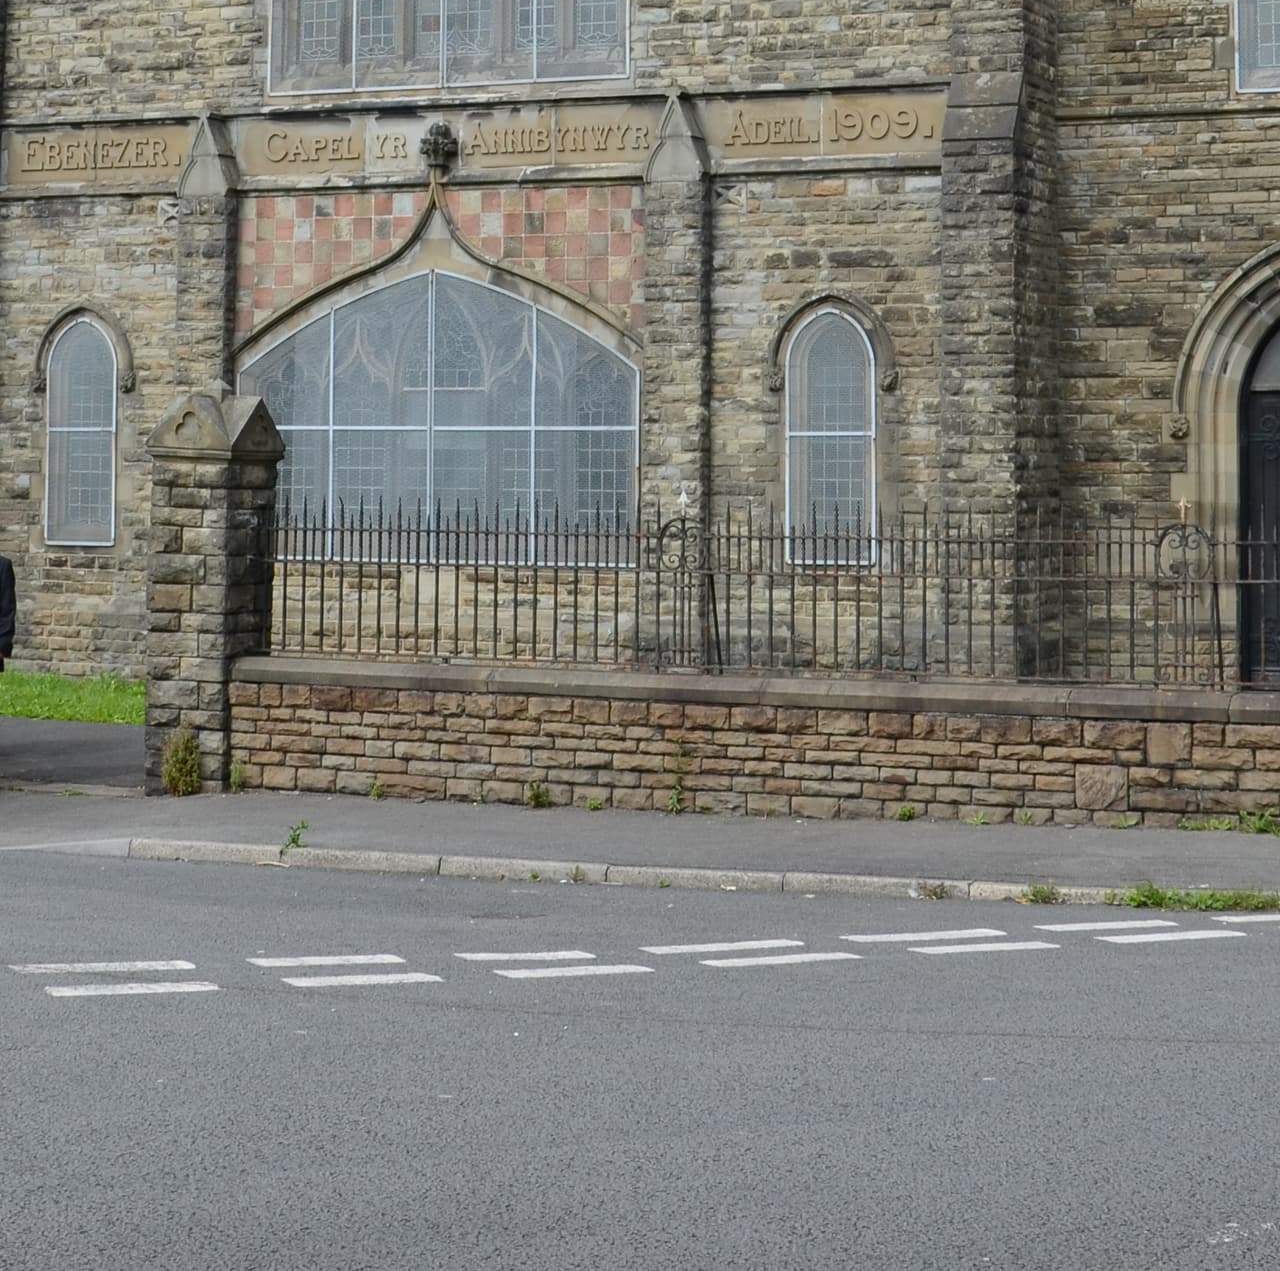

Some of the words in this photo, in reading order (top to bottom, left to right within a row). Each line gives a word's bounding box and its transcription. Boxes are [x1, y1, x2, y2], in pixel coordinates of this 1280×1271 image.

[263, 128, 360, 164] CAPEL
[374, 132, 408, 160] YR
[464, 119, 651, 156] ANNIBYNWYR
[724, 108, 820, 146] ADEIL.
[828, 106, 934, 143] 1909.
